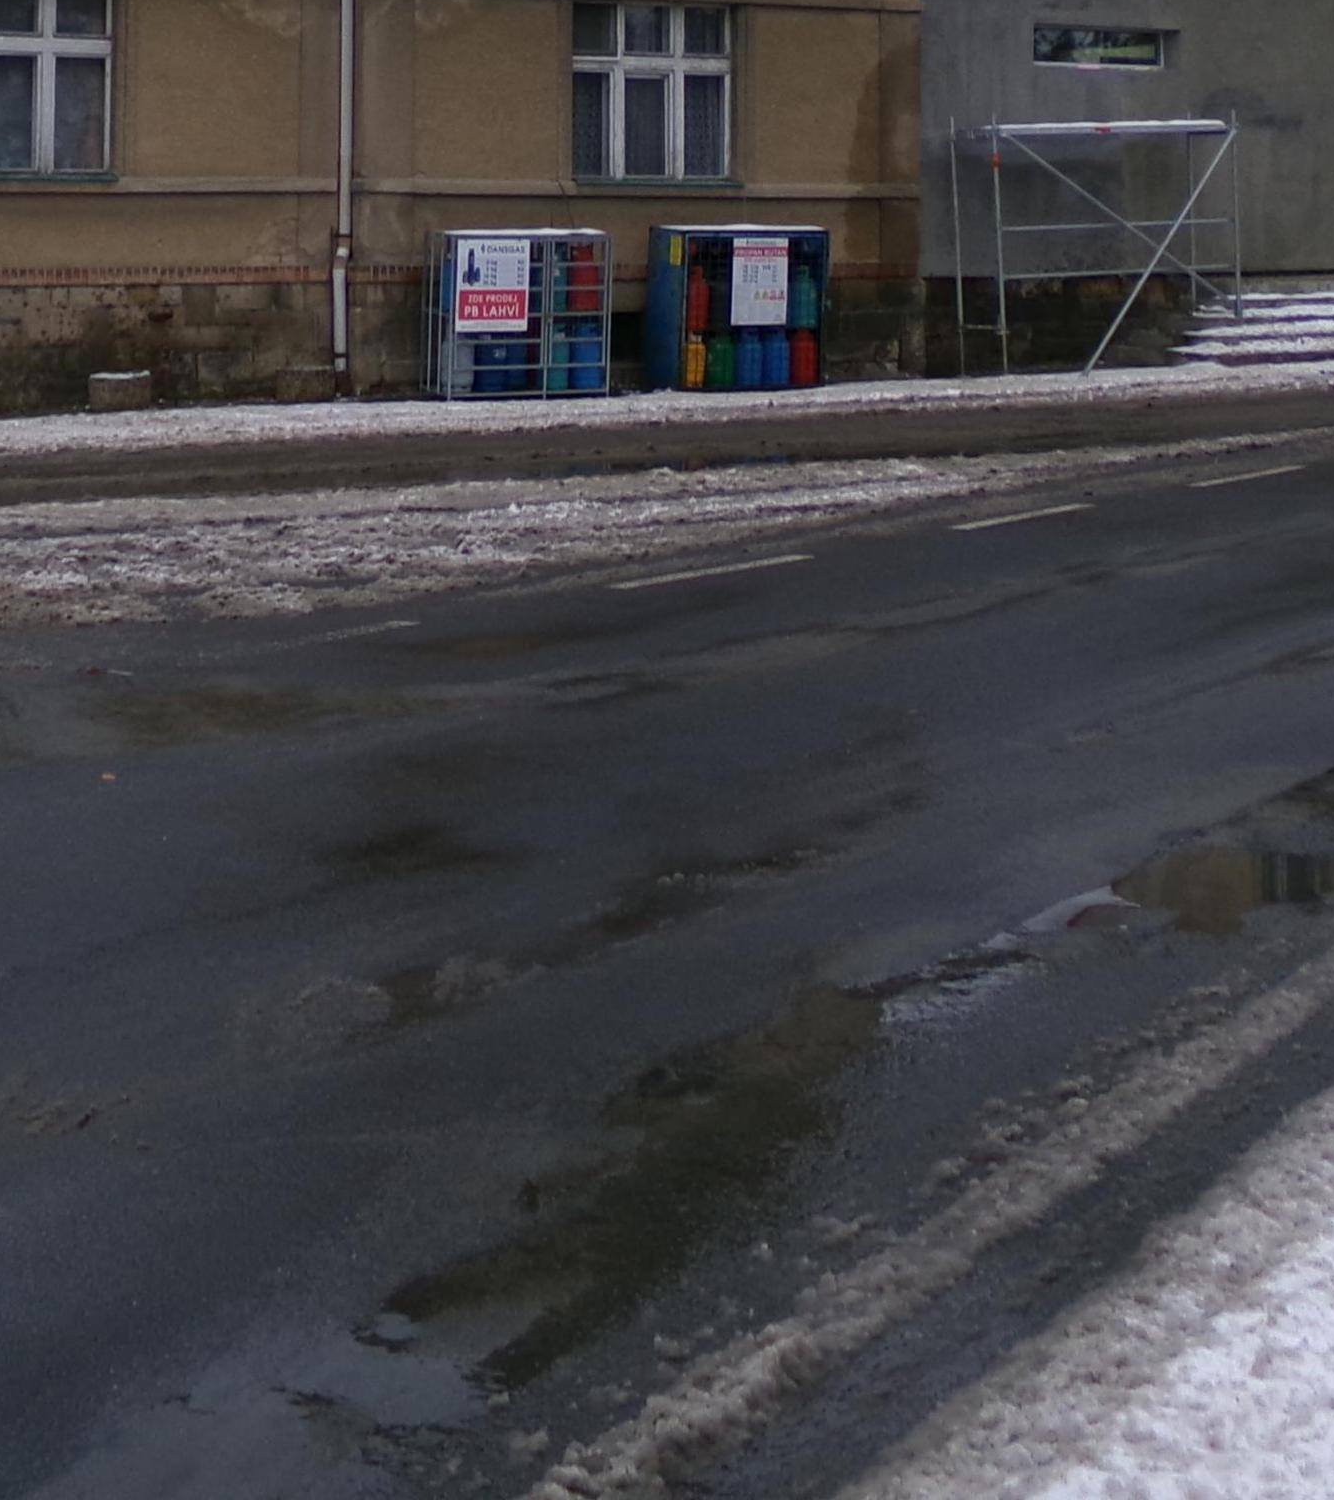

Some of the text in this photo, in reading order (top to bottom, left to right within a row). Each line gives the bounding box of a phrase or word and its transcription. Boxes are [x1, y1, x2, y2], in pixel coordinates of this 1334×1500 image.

[468, 293, 518, 303] ZDE PRODEJ
[464, 302, 520, 317] PB LAHVÍ
